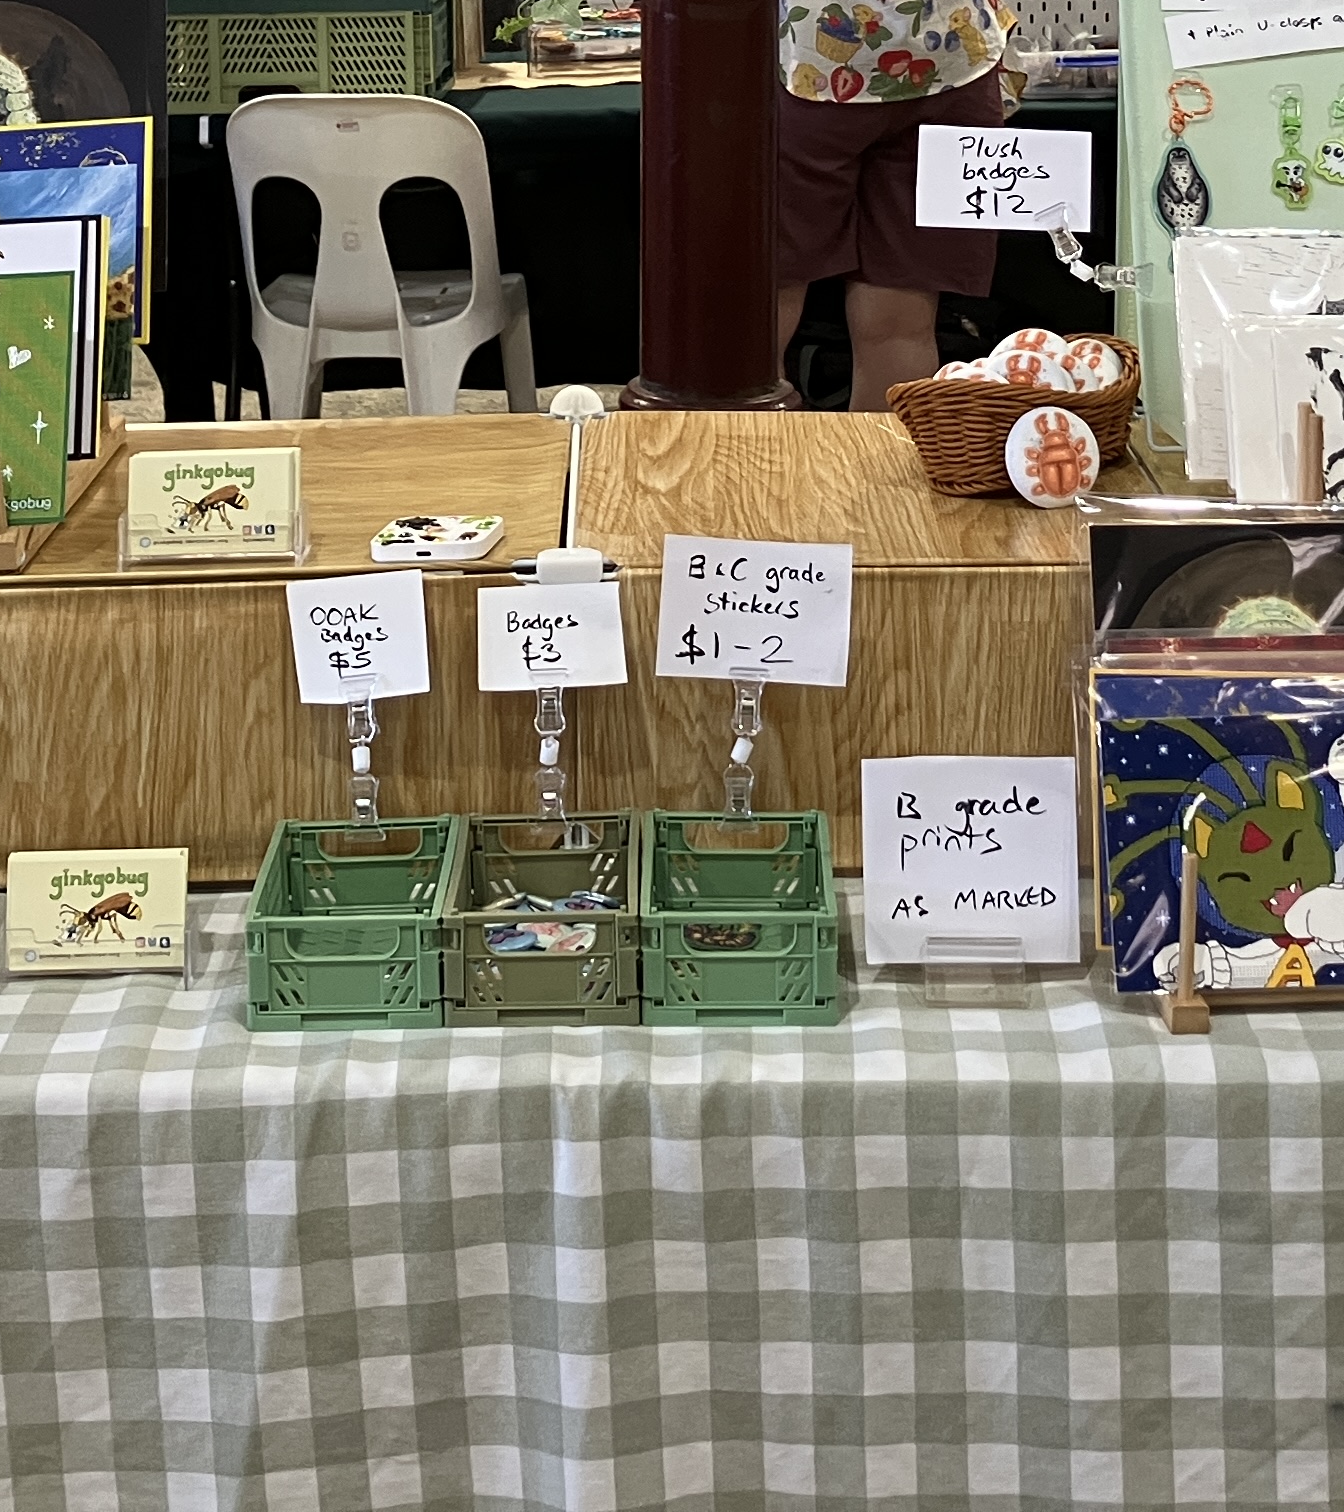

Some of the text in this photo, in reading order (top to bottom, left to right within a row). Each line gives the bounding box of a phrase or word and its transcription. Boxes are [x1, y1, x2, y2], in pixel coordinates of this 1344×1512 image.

[959, 136, 1023, 160] Plush
[962, 162, 1050, 191] badges
[960, 186, 1034, 220] $12
[162, 461, 255, 492] ginkgobug
[689, 555, 706, 579] B
[730, 557, 748, 581] C
[766, 562, 826, 593] grade
[310, 603, 379, 626] OOAK
[506, 611, 580, 638] Badges
[329, 650, 372, 679] $5
[522, 639, 562, 670] $3
[897, 785, 1047, 836] B grade
[901, 824, 1003, 872] prints
[49, 866, 149, 900] ginkgobug
[891, 886, 1057, 920] AS MARKED
